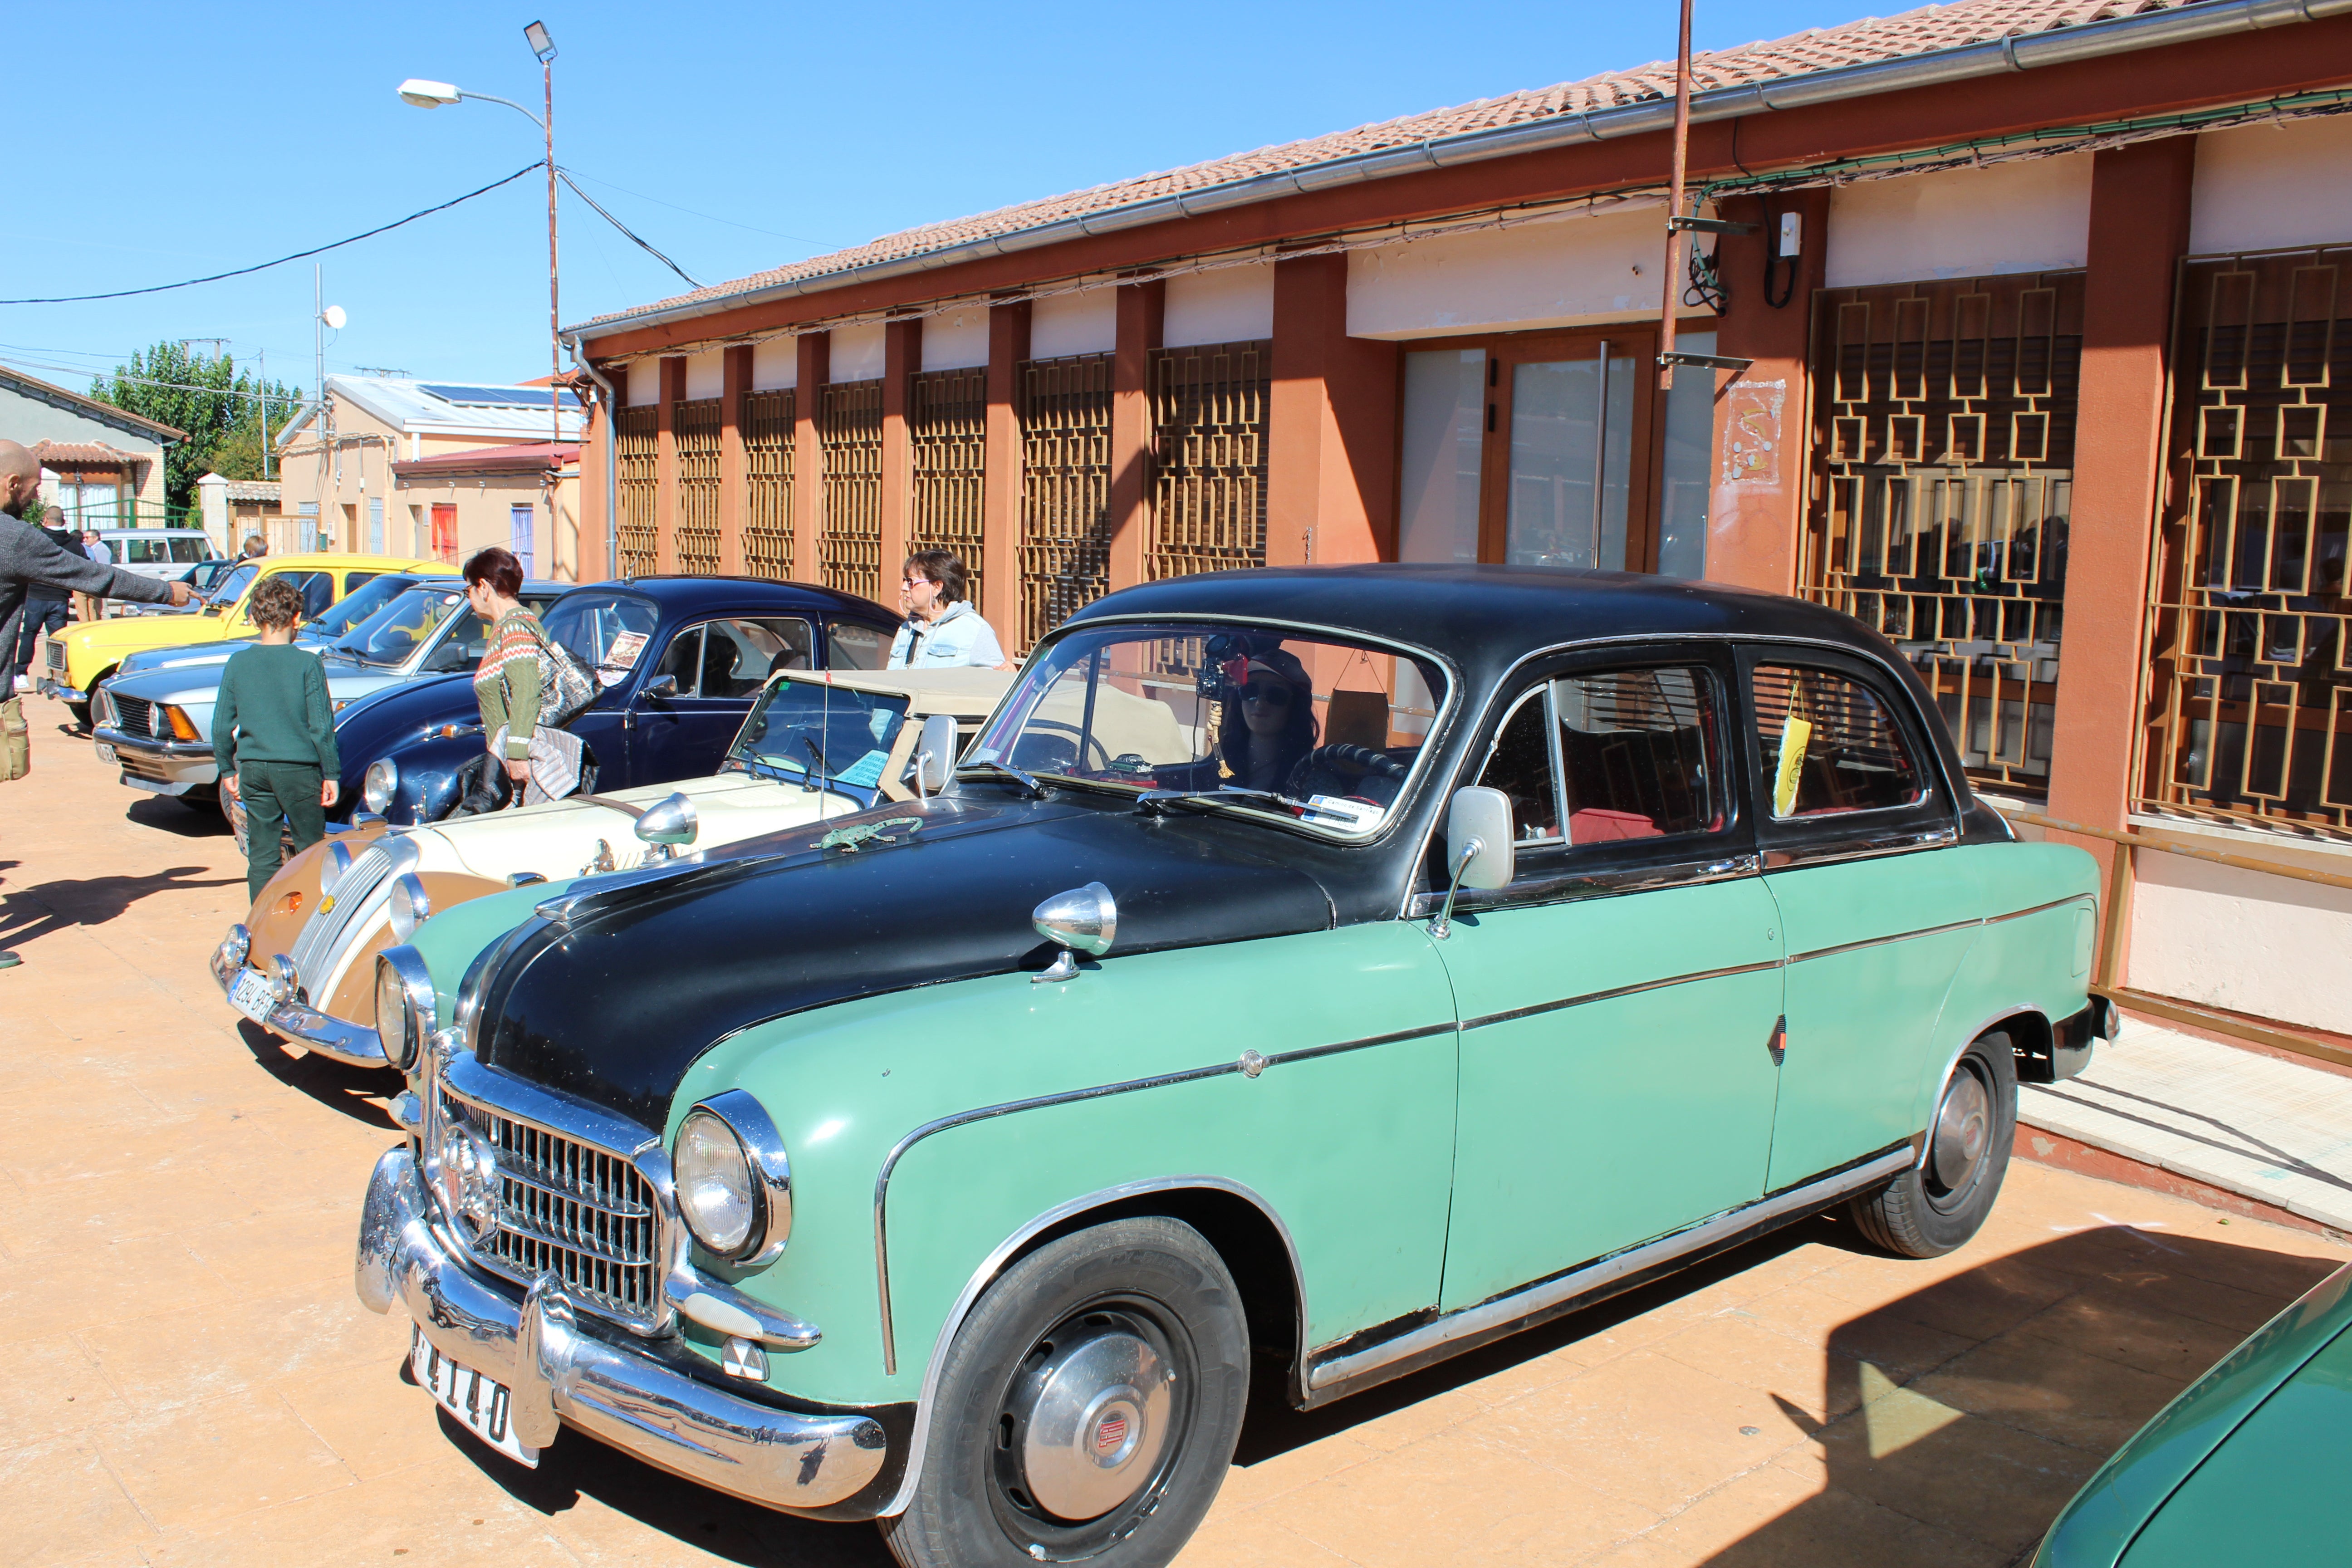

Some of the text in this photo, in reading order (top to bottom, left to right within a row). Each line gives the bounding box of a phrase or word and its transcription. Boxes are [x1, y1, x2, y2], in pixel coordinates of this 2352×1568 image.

[1328, 799, 1347, 807] Camino
[1356, 805, 1379, 814] Santiago
[234, 978, 259, 1006] 1294
[1098, 1418, 1126, 1448] SEAT
